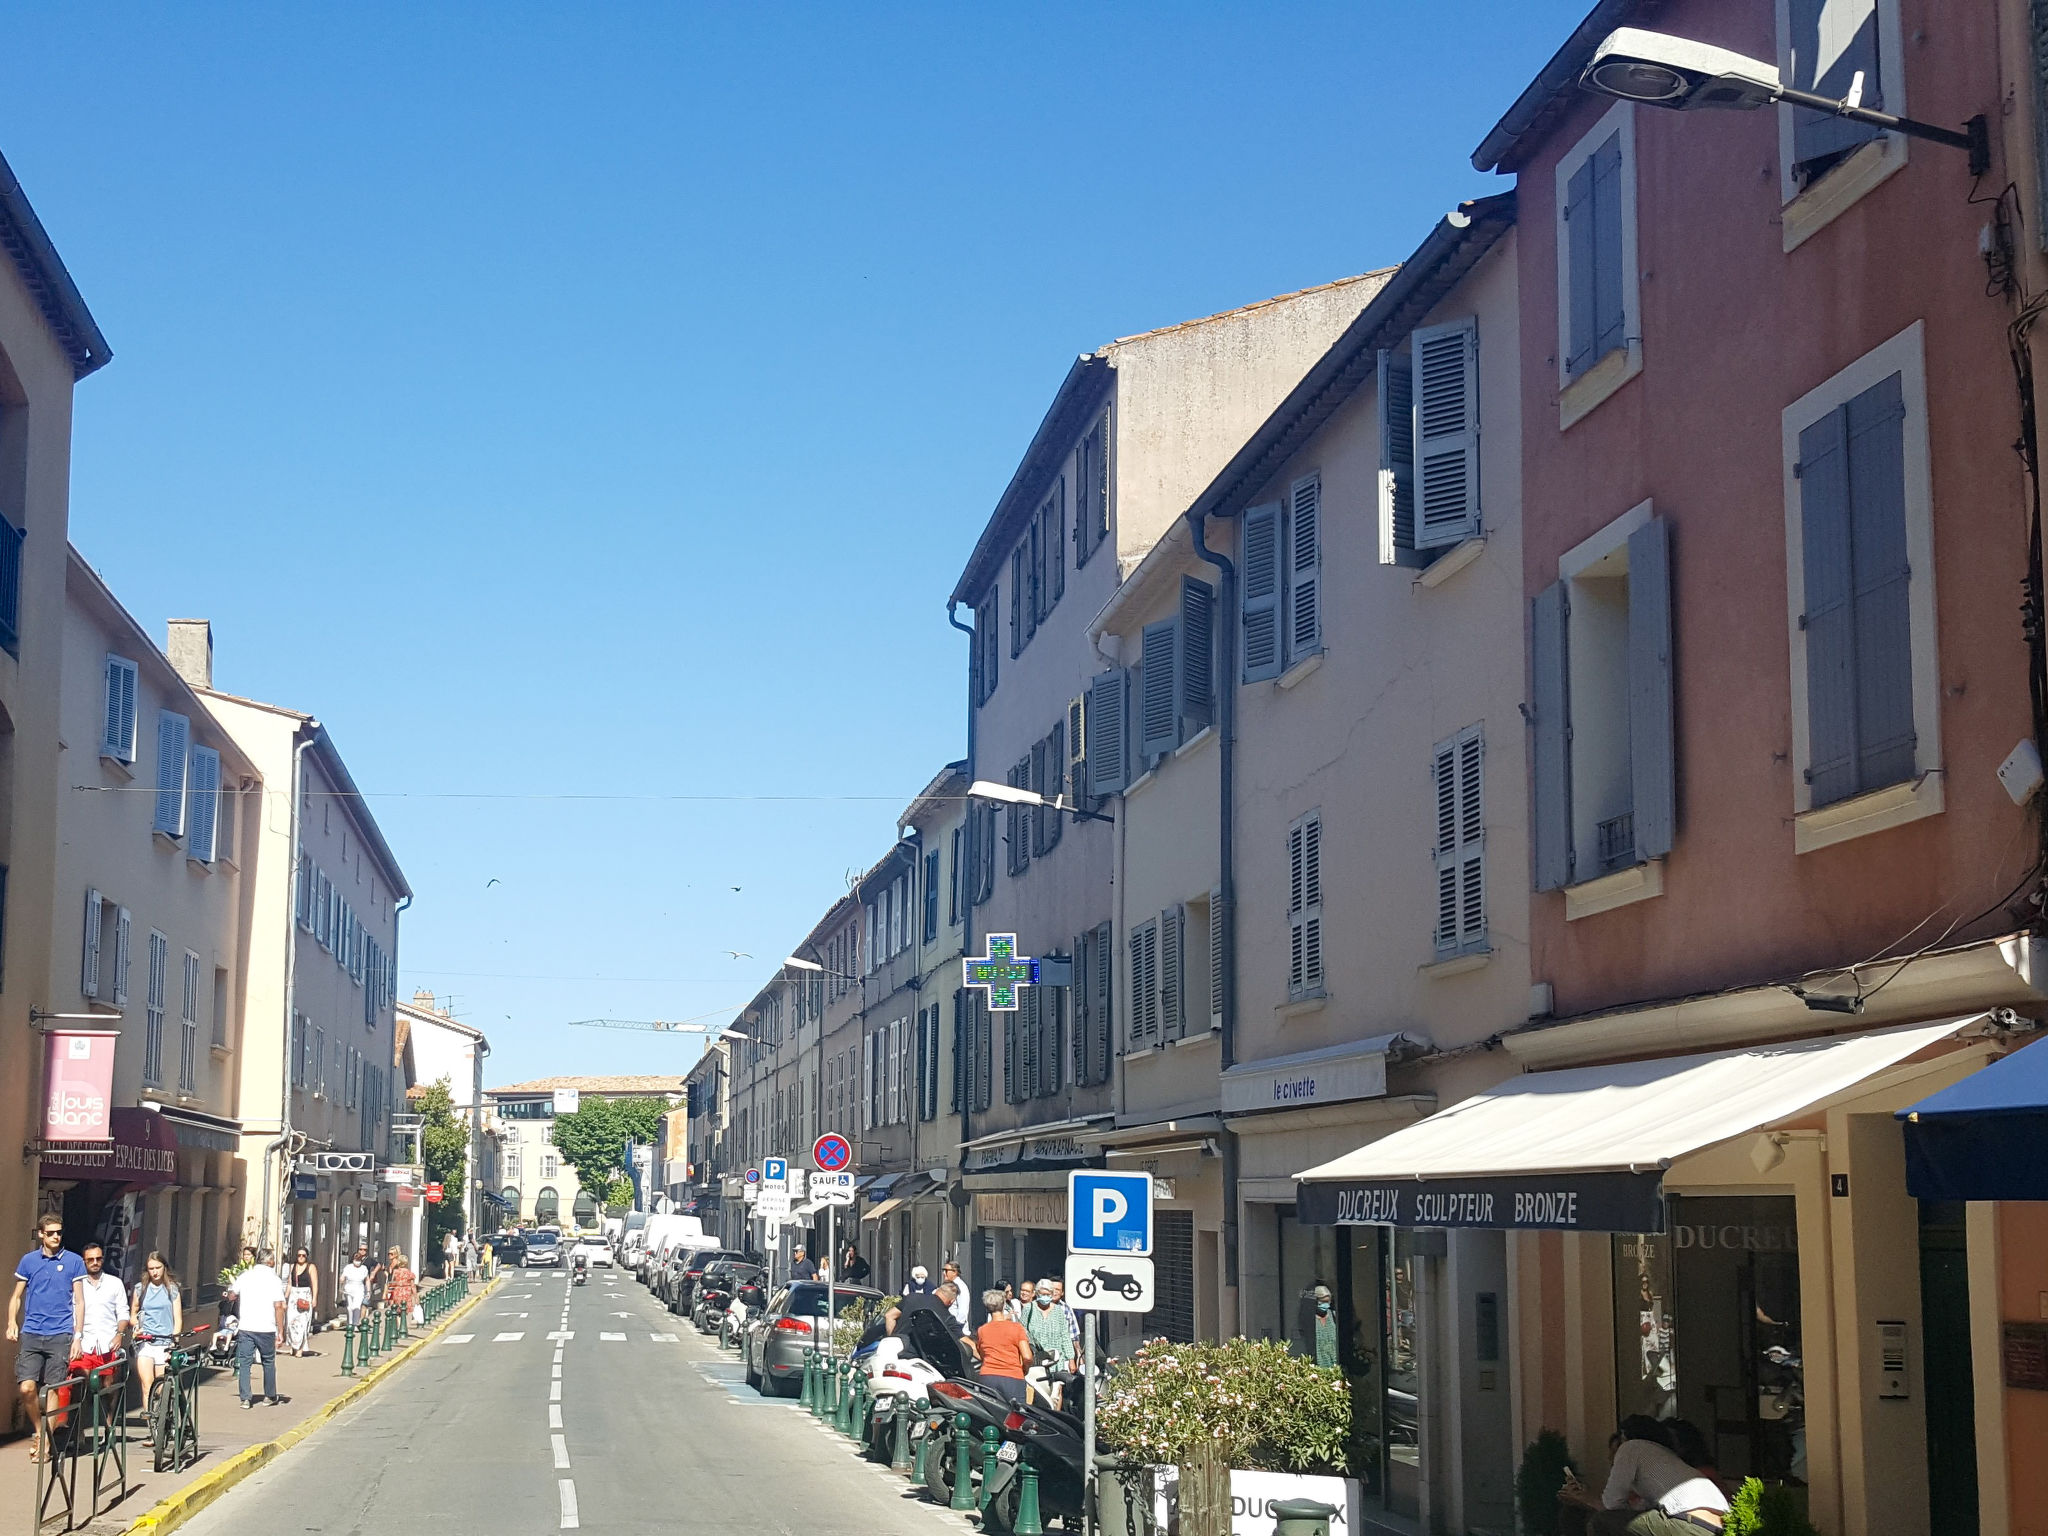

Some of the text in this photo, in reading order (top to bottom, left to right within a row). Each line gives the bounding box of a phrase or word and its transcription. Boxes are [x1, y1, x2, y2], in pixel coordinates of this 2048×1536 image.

[1274, 1076, 1315, 1100] le civette
[61, 1091, 104, 1110] louis
[47, 1107, 103, 1125] blanc
[116, 1145, 175, 1172] ESPACE DES LICES
[812, 1176, 837, 1185] SAUF
[1837, 1178, 1843, 1192] 4
[984, 1195, 1032, 1223] PHARMACIE
[1092, 1187, 1128, 1238] P
[1337, 1189, 1577, 1224] DUCREUX SCULPTEUR BRONZE
